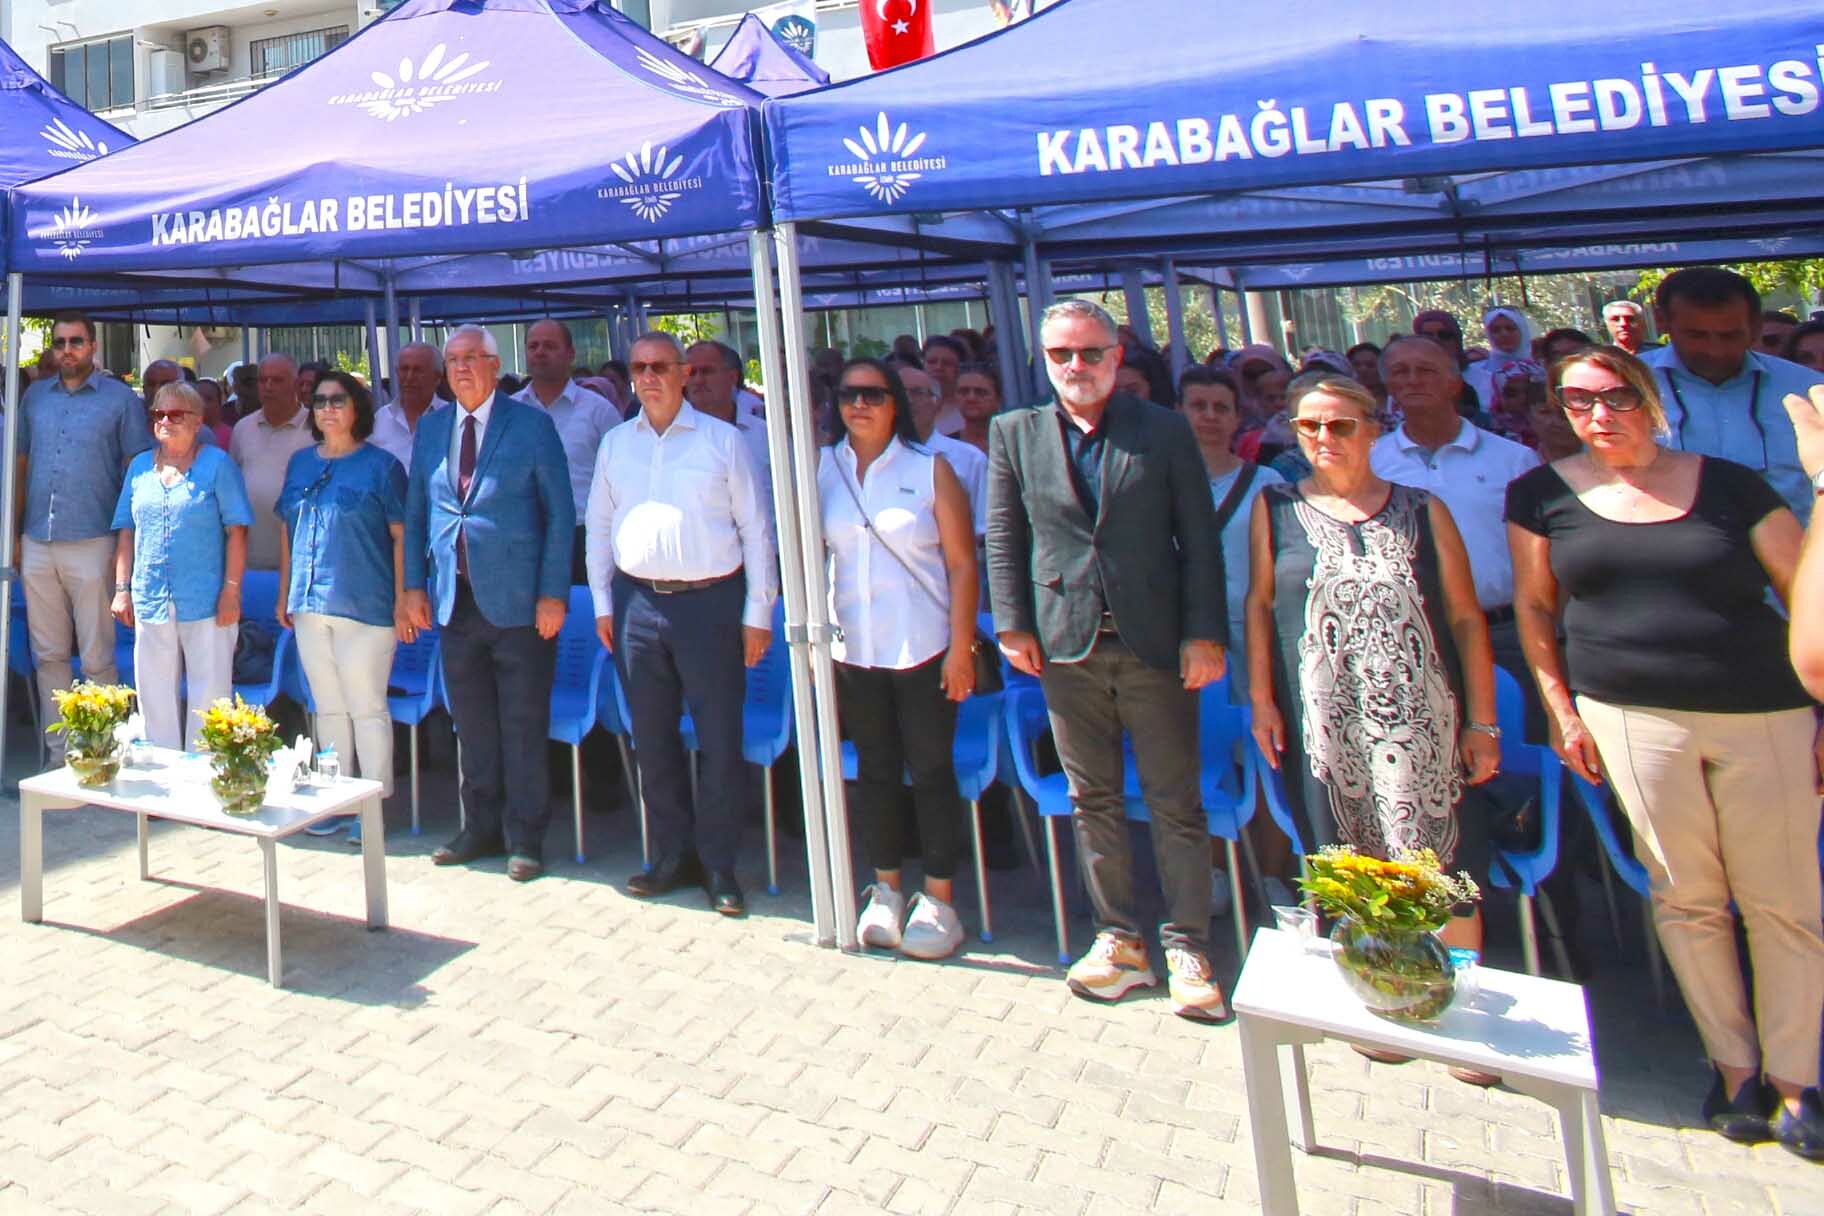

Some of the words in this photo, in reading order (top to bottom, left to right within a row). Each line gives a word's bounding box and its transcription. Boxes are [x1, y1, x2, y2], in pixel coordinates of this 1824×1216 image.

[1035, 98, 1412, 177] KARABAĞLAR
[597, 183, 651, 199] KARABAĞLAR
[653, 175, 703, 193] BELEDİYESİ
[827, 161, 887, 177] KARABAĞLAR
[890, 155, 946, 173] BELEDİYESİ
[151, 195, 339, 247] KARABAĞLAR
[346, 175, 529, 232] BELEDİYESİ
